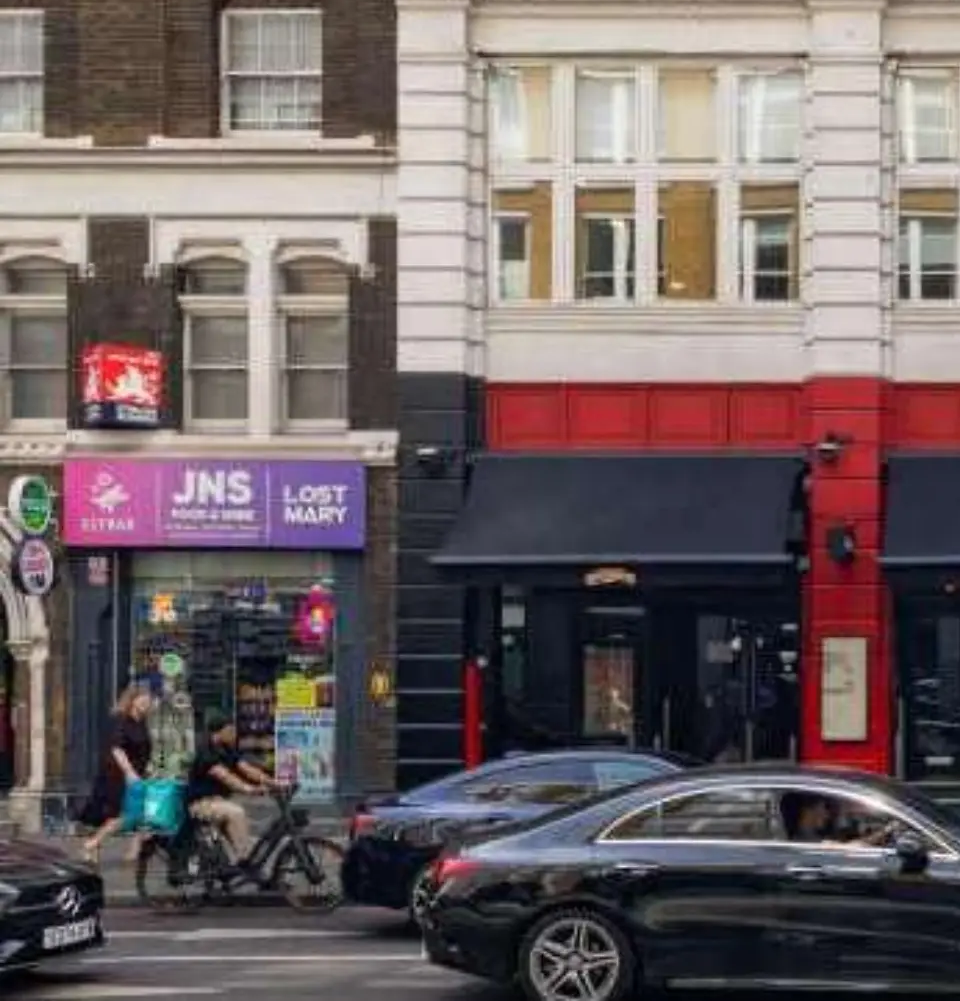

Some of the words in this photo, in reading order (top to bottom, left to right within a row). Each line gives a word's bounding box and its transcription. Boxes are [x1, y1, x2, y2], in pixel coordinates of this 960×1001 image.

[174, 471, 253, 505] JNS
[282, 485, 348, 504] LOST
[283, 506, 348, 525] MARY
